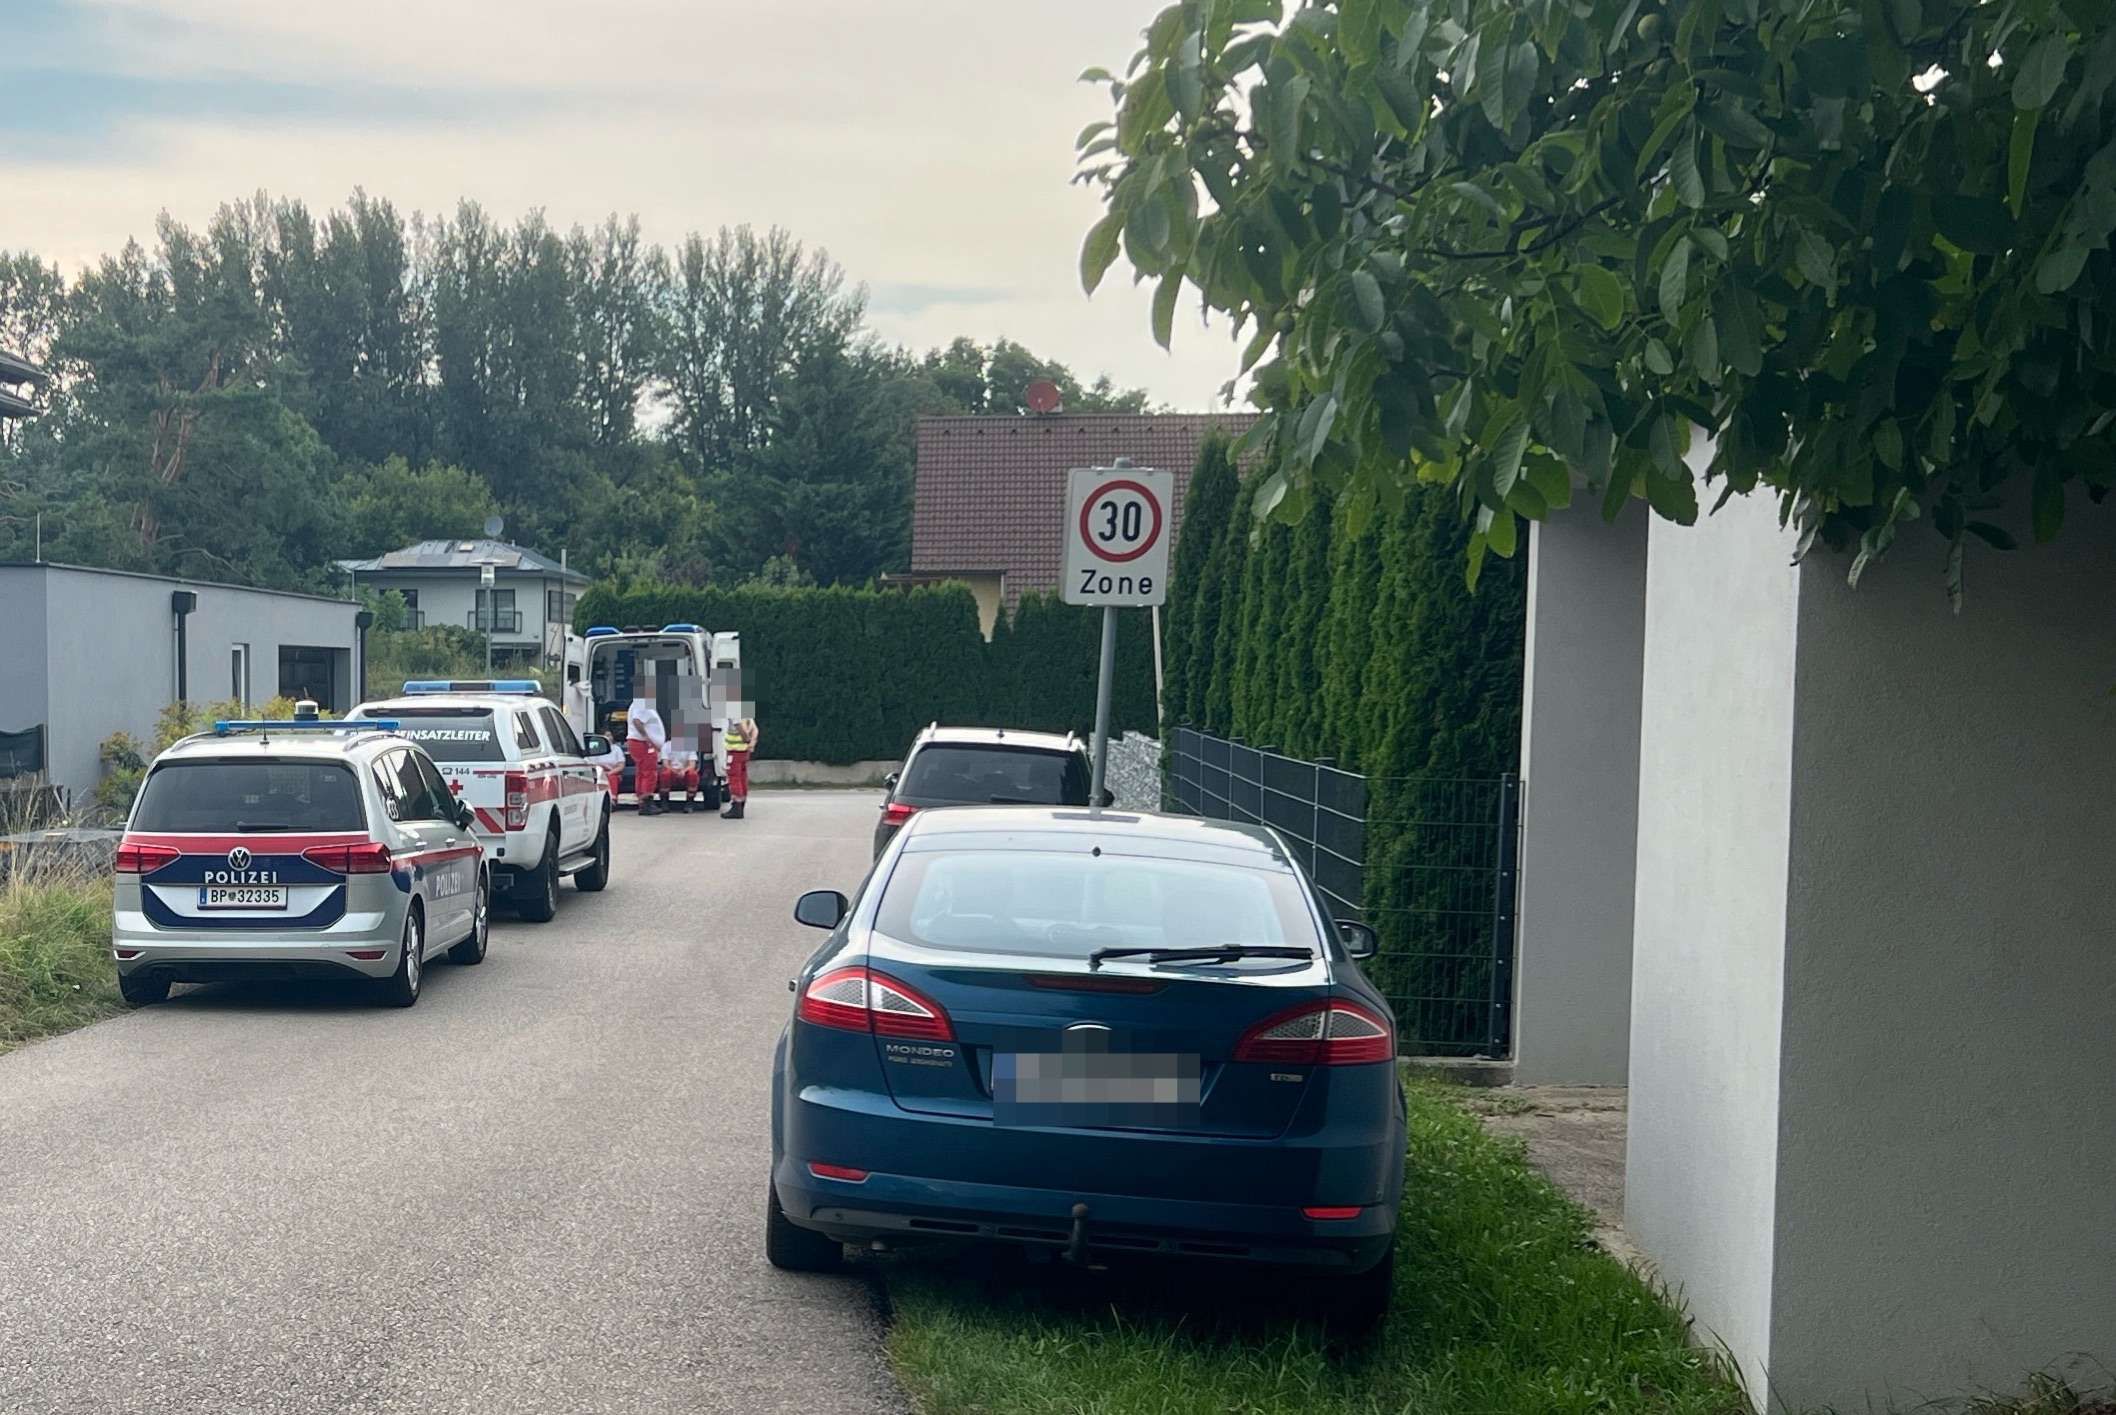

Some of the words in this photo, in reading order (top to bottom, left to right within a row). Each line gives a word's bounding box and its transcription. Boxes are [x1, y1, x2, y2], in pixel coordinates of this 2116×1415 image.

[1098, 501, 1142, 542] 30
[1080, 569, 1153, 595] Zone
[394, 729, 491, 742] EINSATZLEITER
[455, 767, 470, 775] 144
[204, 871, 277, 884] POLIZEI
[435, 871, 464, 897] POLIZEI
[211, 889, 227, 903] BP
[237, 889, 279, 903] 32335
[886, 1044, 955, 1058] MONDEO
